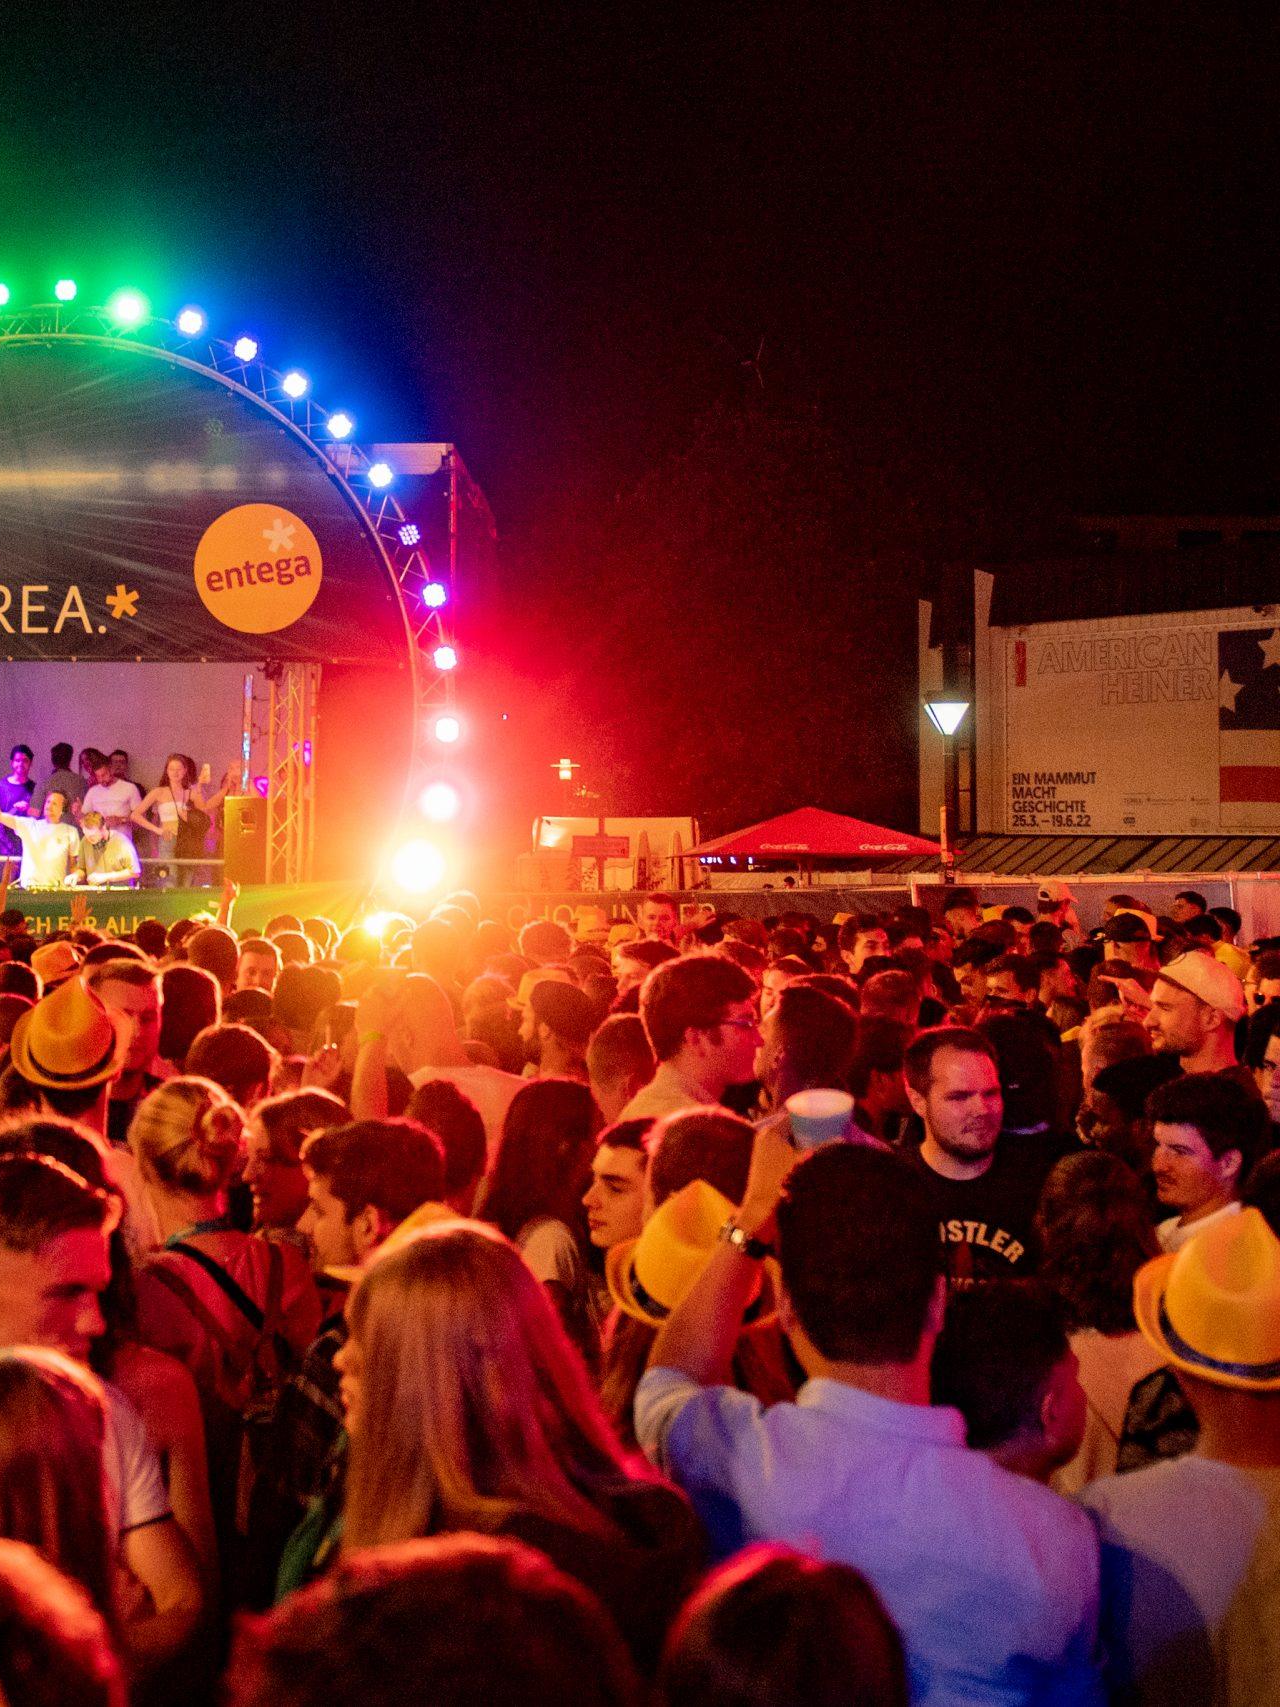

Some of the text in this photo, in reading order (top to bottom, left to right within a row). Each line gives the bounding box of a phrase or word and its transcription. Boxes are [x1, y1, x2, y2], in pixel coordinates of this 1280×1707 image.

[205, 554, 313, 592] entega
[1036, 631, 1214, 675] AMERICAN
[1100, 668, 1217, 705] HEINER
[1012, 771, 1096, 785] EIN MAMMUT
[1012, 786, 1057, 799] MACHT
[1012, 800, 1086, 813] GESCHICHTE
